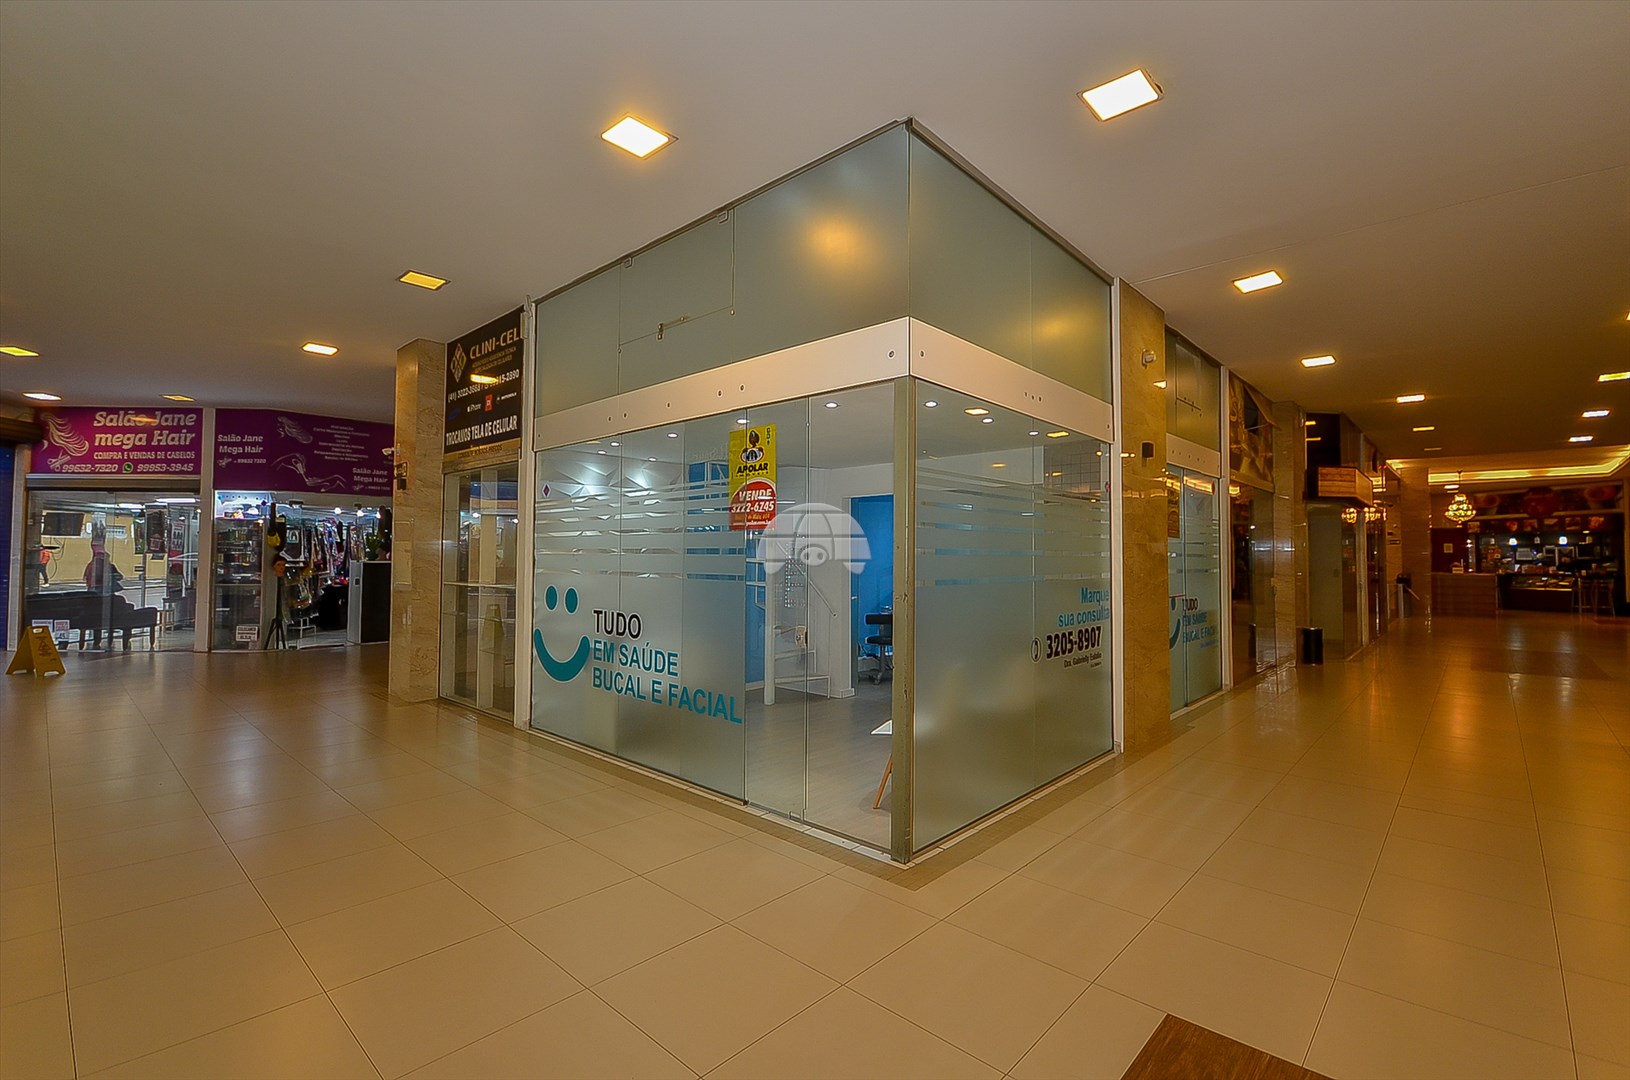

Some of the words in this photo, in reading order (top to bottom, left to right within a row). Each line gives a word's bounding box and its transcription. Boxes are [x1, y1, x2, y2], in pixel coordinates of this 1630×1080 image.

[470, 328, 519, 359] CLINI-CEL
[93, 410, 148, 426] Salão
[151, 411, 197, 426] Jane
[471, 424, 484, 440] TELA
[485, 421, 492, 437] DE
[492, 415, 518, 434] CELULAR
[94, 434, 147, 449] mega
[151, 429, 196, 446] Hair
[217, 434, 241, 442] Salão
[243, 434, 263, 443] Jane
[94, 452, 122, 460] COMPRA
[124, 452, 128, 460] E
[129, 451, 156, 460] VENDAS
[157, 451, 165, 459] DE
[167, 451, 195, 459] CABELOS
[219, 445, 243, 455] Mega
[244, 445, 264, 453] Hair
[736, 462, 769, 475] APOLAR
[739, 489, 772, 501] VENDE
[731, 501, 774, 513] 3222-6745
[1081, 587, 1109, 606] Marque
[593, 610, 642, 639] TUDO
[1059, 615, 1075, 628] sua
[1076, 606, 1110, 623] consulta
[1046, 626, 1102, 659] 3205-8907
[593, 640, 614, 664] EM
[619, 642, 678, 676] SAÚDE
[593, 667, 646, 700] BUCAL
[652, 680, 662, 704] E
[669, 684, 742, 724] FACIAL
